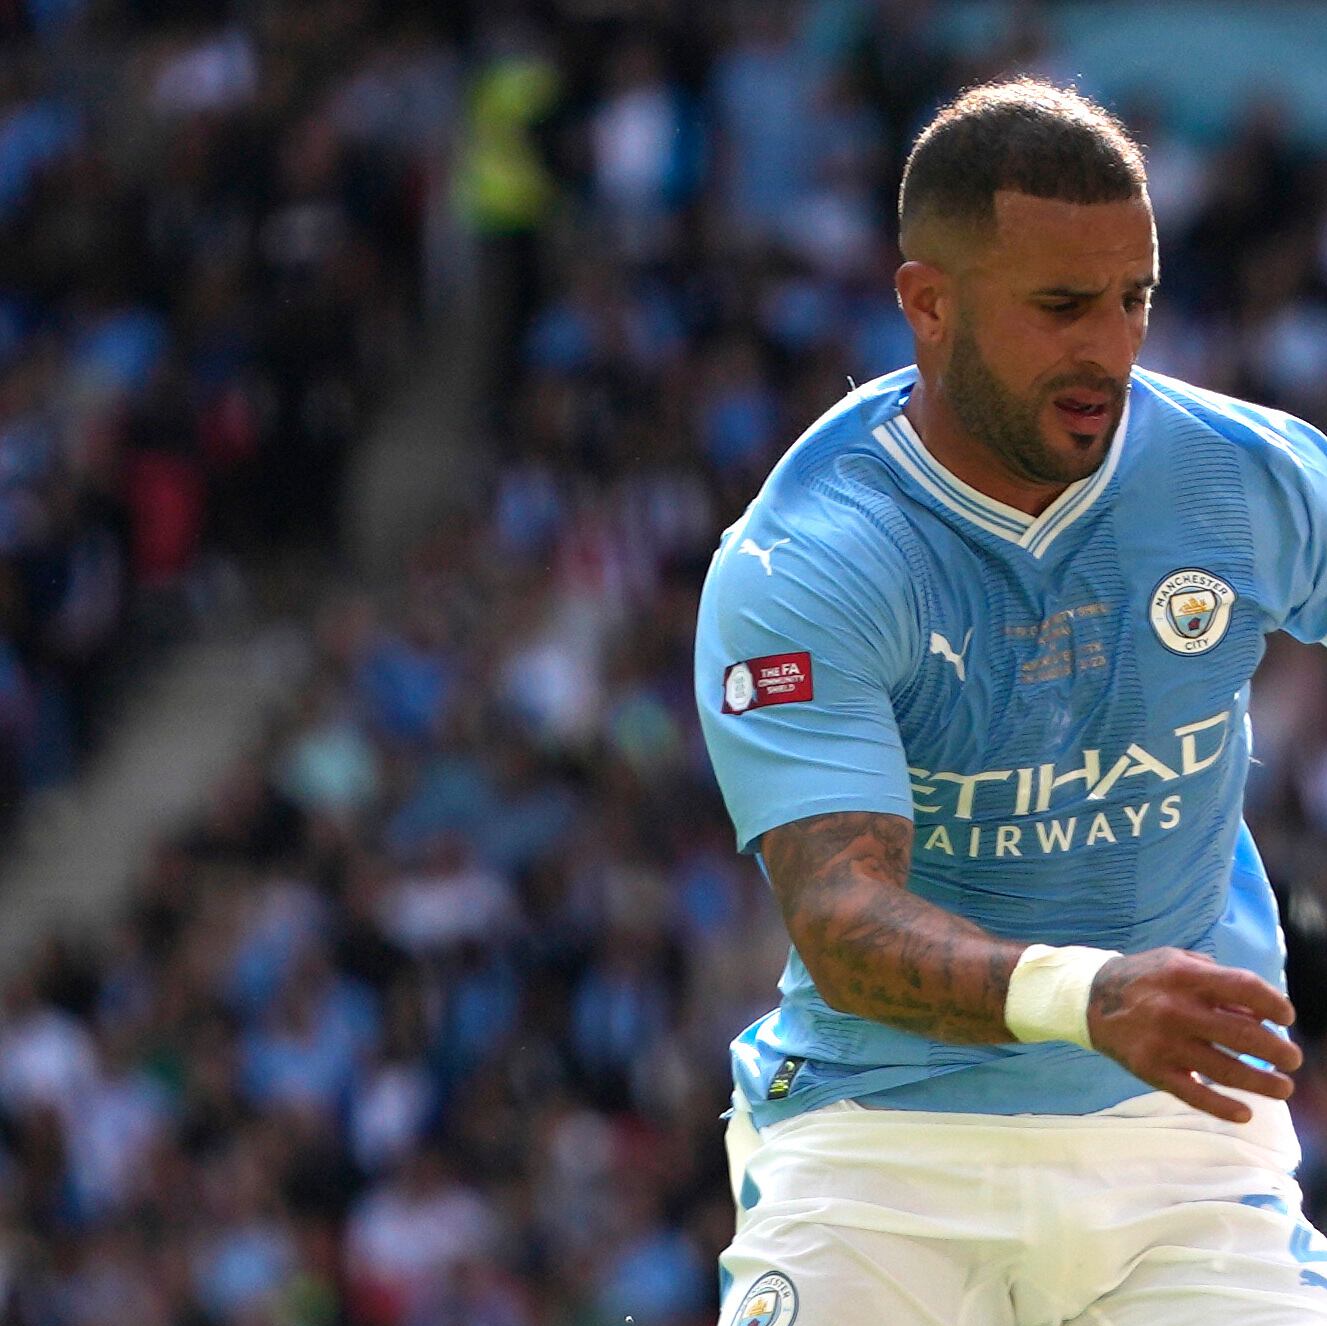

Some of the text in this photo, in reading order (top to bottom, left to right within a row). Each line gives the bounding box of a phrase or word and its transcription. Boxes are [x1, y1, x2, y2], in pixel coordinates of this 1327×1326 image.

[1155, 574, 1229, 608] MANCHESTER
[1185, 638, 1209, 651] CITY
[760, 662, 800, 678] THE FA
[924, 795, 1182, 858] AIRWAYS
